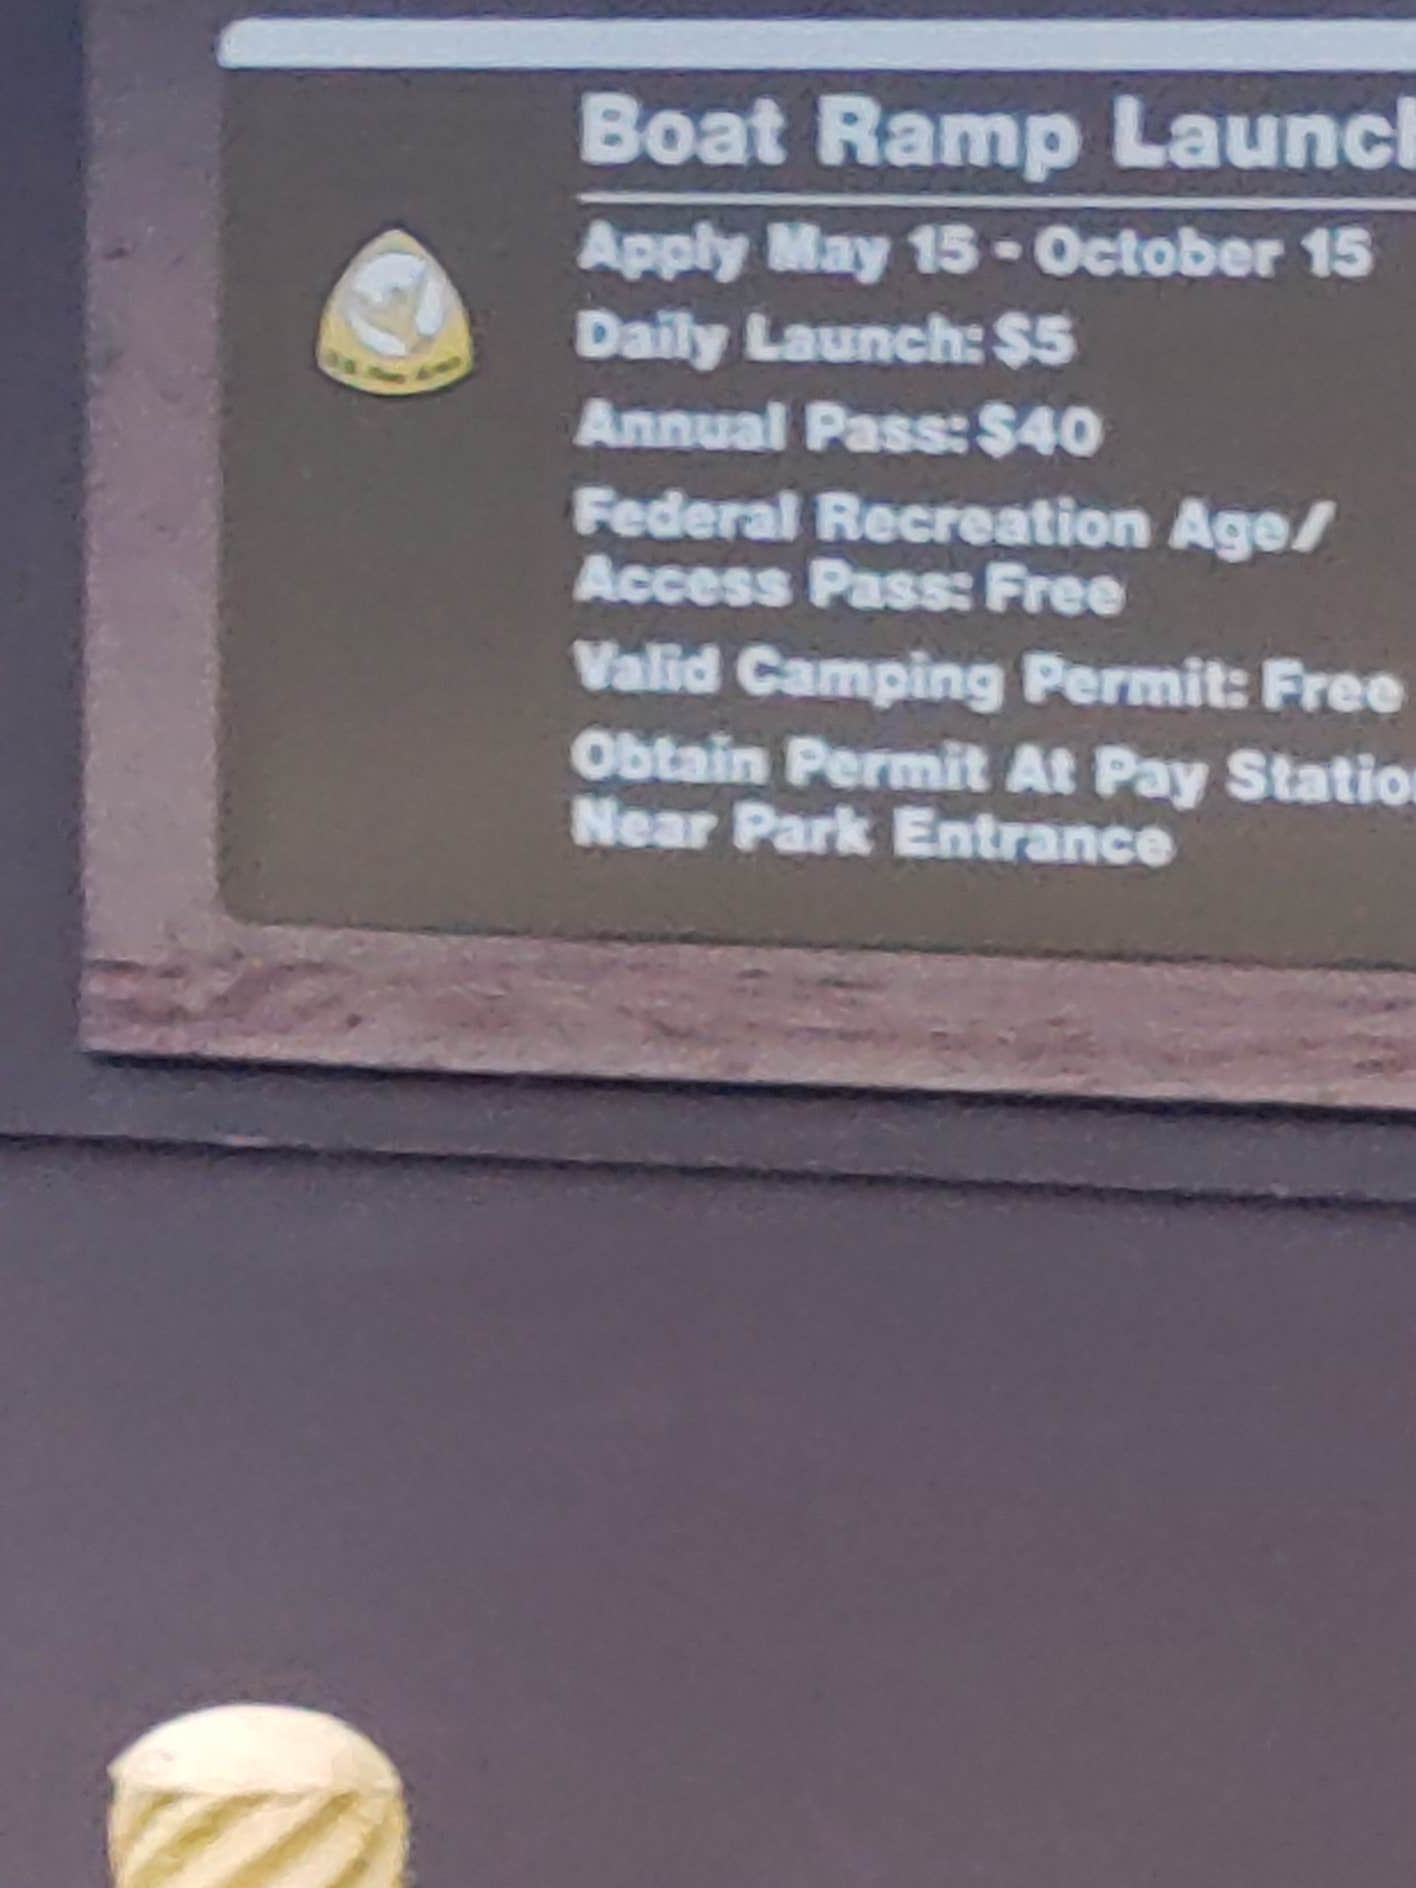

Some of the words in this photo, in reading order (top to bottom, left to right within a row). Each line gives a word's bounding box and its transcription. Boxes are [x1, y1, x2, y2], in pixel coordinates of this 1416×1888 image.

[580, 92, 788, 167] Boat
[817, 93, 1083, 184] Ramp
[576, 219, 751, 284] Apply
[767, 219, 893, 286] May
[907, 222, 980, 275] 15
[1034, 225, 1286, 278] October
[1300, 224, 1376, 279] 15
[575, 308, 731, 372] Daily
[744, 311, 986, 366] Launch:
[991, 310, 1078, 371] $5
[573, 398, 788, 451] Annual
[805, 400, 970, 456] Pass:
[975, 400, 1105, 460] $40
[572, 485, 800, 542] Federal
[815, 490, 1152, 550] Recreation
[1168, 497, 1336, 564] Age/
[573, 552, 794, 609] Access
[808, 556, 978, 611] Pass:
[985, 561, 1126, 618] Free
[572, 639, 723, 696] Valid
[735, 643, 1006, 714] Camping
[1022, 650, 1251, 709] Permit:
[1259, 657, 1408, 715] Free
[570, 725, 771, 786] Obtain
[784, 734, 991, 794] Permit
[1002, 741, 1079, 797] At
[1093, 744, 1210, 811] Pay
[571, 794, 718, 851] Near
[730, 800, 875, 858] Park
[893, 805, 1177, 868] Entrance
